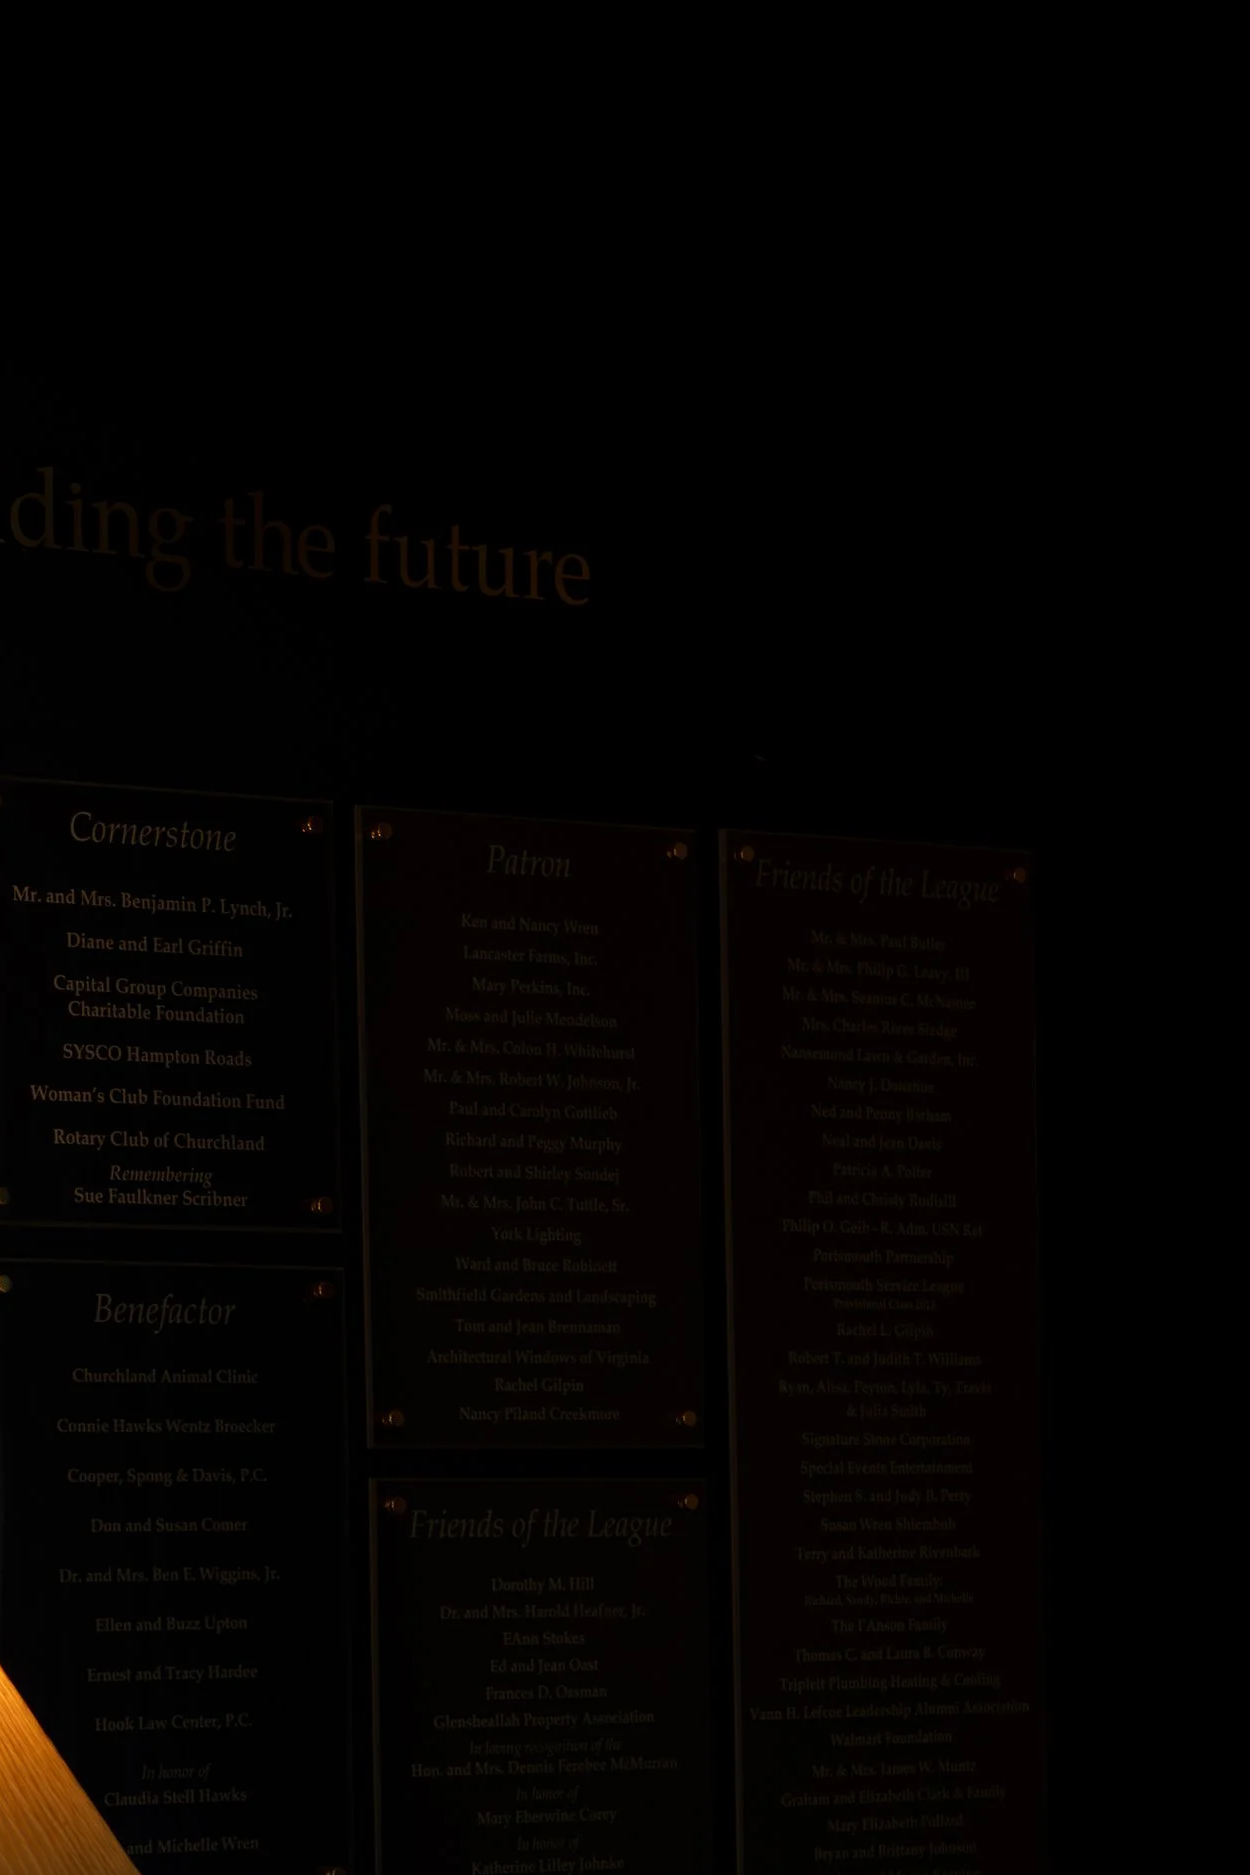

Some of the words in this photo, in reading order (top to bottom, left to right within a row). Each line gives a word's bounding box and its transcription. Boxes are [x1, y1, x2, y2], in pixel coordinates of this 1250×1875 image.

[219, 490, 335, 580] the
[364, 504, 590, 606] future
[70, 811, 236, 852] Cornerstone
[487, 845, 570, 878] Patron
[756, 859, 843, 892] Friends
[851, 866, 875, 904] of
[880, 868, 913, 896] the
[921, 869, 999, 909] League
[13, 885, 41, 902] Mr.
[46, 889, 75, 904] and
[81, 890, 115, 907] Mrs.
[121, 892, 196, 913] Benjamin
[202, 897, 215, 912] P.
[220, 898, 271, 919] Lynch,
[276, 902, 292, 920] Jr.
[67, 932, 114, 950] Diane
[119, 936, 147, 951] and
[153, 937, 183, 953] Earl
[188, 940, 243, 957] Griffin
[53, 974, 110, 996] Capital
[116, 978, 166, 1000] Group
[171, 981, 258, 1003] Companies
[68, 1001, 150, 1019] Charitable
[156, 1005, 244, 1024] Foundation
[63, 1044, 121, 1060] SYSCO
[127, 1046, 199, 1068] Hampton
[205, 1050, 252, 1067] Roads
[109, 1088, 147, 1104] Club
[153, 1090, 241, 1108] Foundation
[247, 1094, 285, 1109] Fund
[54, 1129, 105, 1150] Rotary
[110, 1131, 149, 1147] Club
[154, 1132, 169, 1148] of
[174, 1133, 264, 1151] Churchland
[110, 1165, 212, 1188] Remembering
[74, 1187, 103, 1203] Sue
[109, 1188, 178, 1205] Faulkner
[183, 1190, 248, 1207] Scribner
[94, 1293, 236, 1334] Benefactor
[72, 1368, 156, 1382] Churchland
[161, 1369, 212, 1383] Animal
[216, 1369, 258, 1383] Clinic
[57, 1419, 109, 1432] Connie
[113, 1418, 162, 1432] Hawks
[166, 1419, 210, 1433] Wentz
[215, 1419, 275, 1433] Broecker
[410, 1509, 503, 1538] Friends
[512, 1508, 539, 1548] of
[544, 1509, 579, 1537] the
[588, 1510, 672, 1547] League
